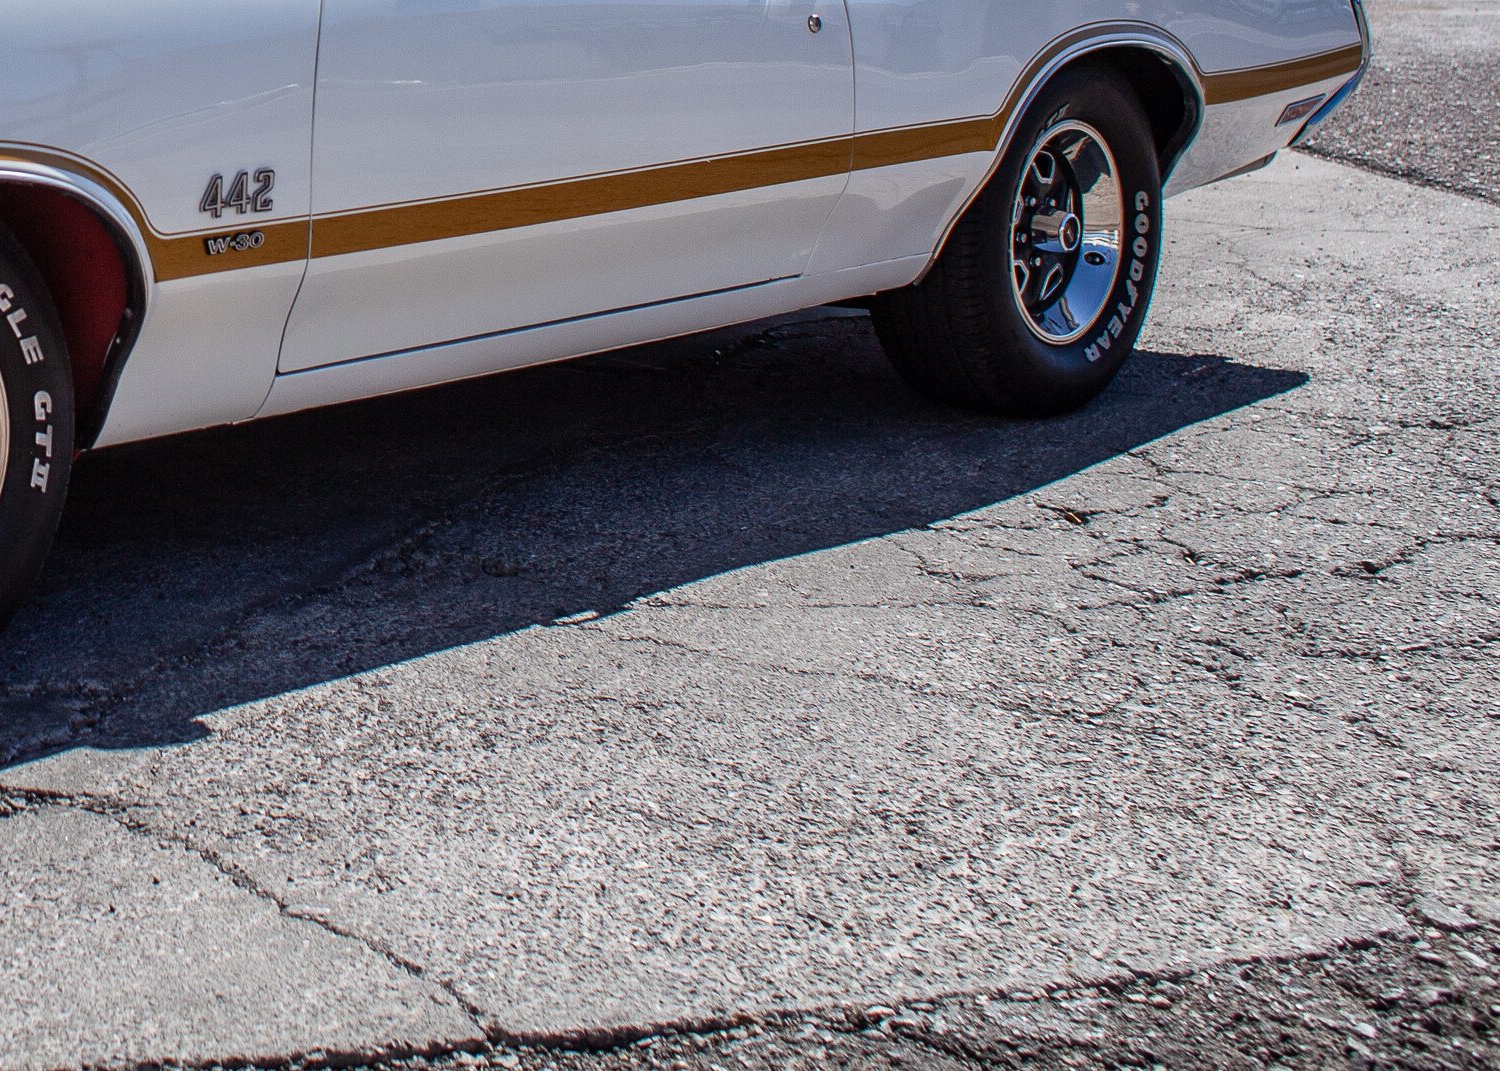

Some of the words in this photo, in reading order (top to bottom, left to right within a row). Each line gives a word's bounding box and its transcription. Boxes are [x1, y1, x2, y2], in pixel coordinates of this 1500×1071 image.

[199, 166, 276, 219] 442
[204, 230, 265, 256] W-30
[1083, 190, 1150, 362] GOODYEAR
